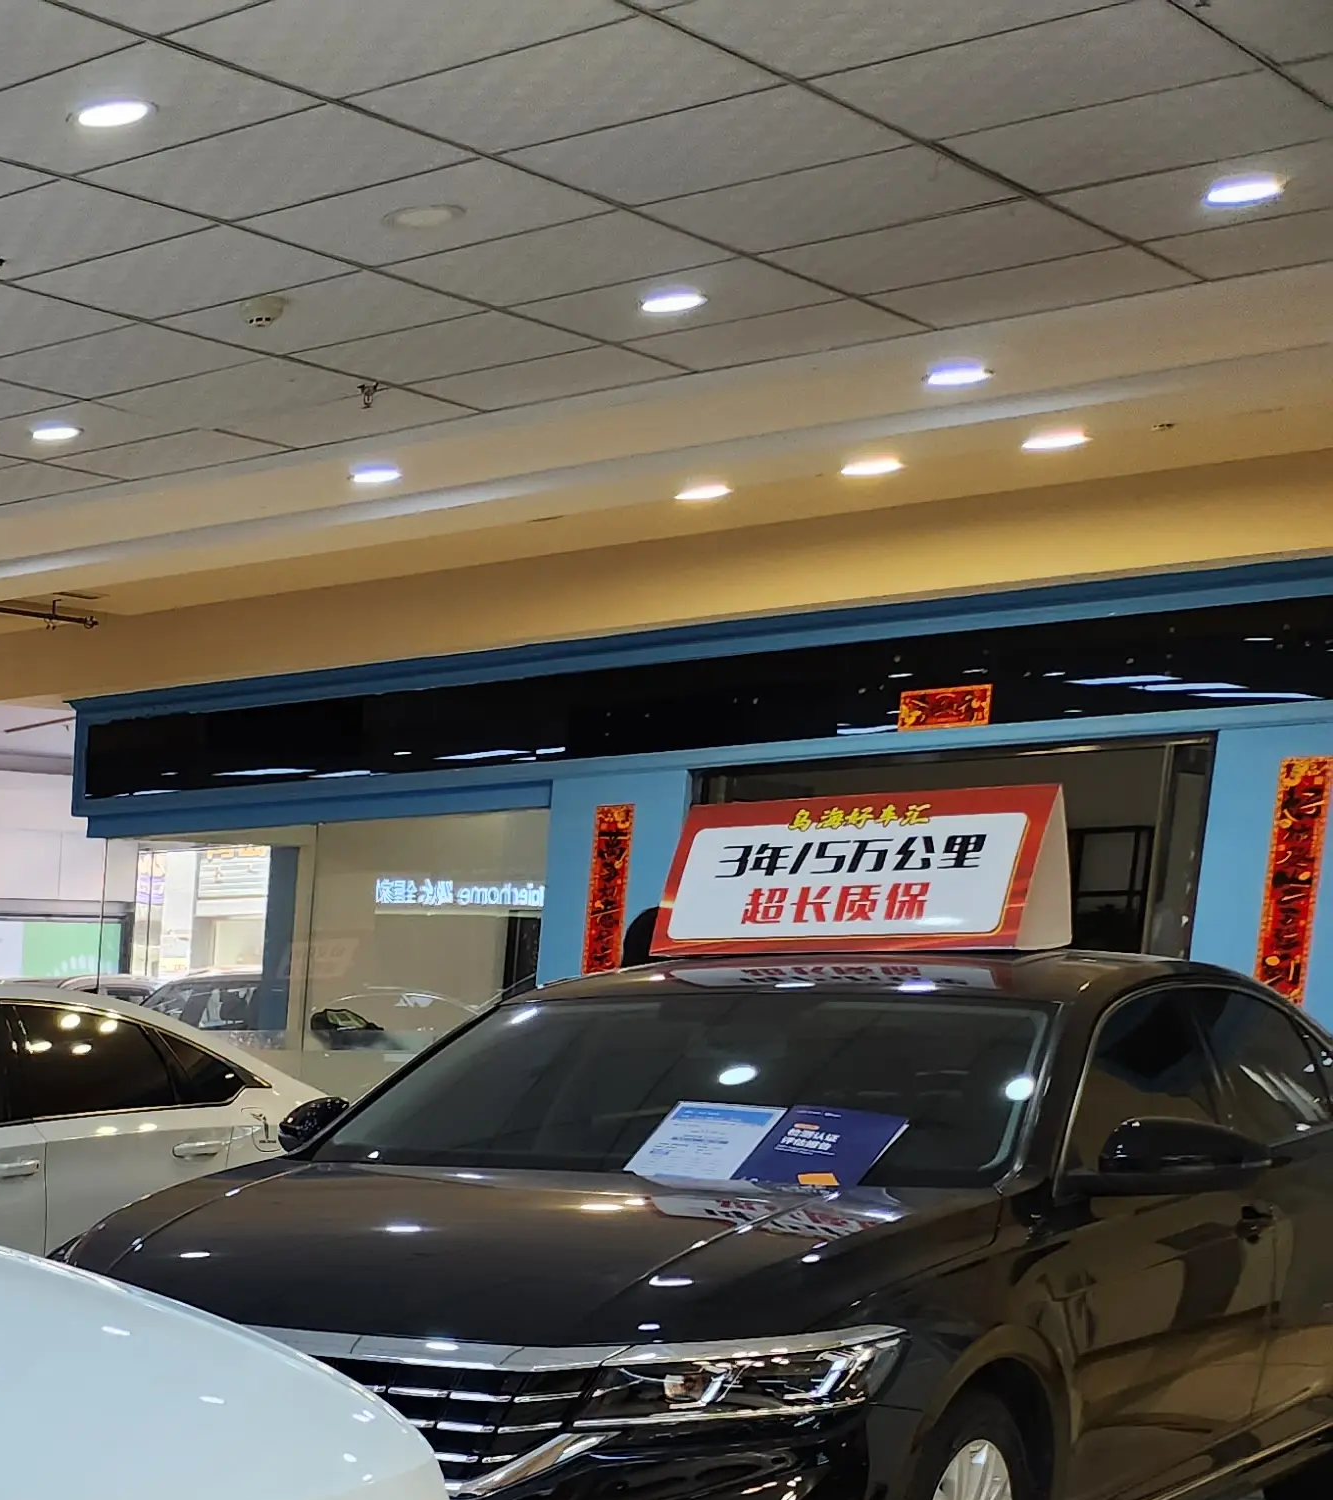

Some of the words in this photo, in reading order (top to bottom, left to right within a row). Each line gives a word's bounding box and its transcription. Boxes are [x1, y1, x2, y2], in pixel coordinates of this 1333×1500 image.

[788, 803, 932, 832] 乌海好车汇
[741, 882, 931, 926] 超长质保
